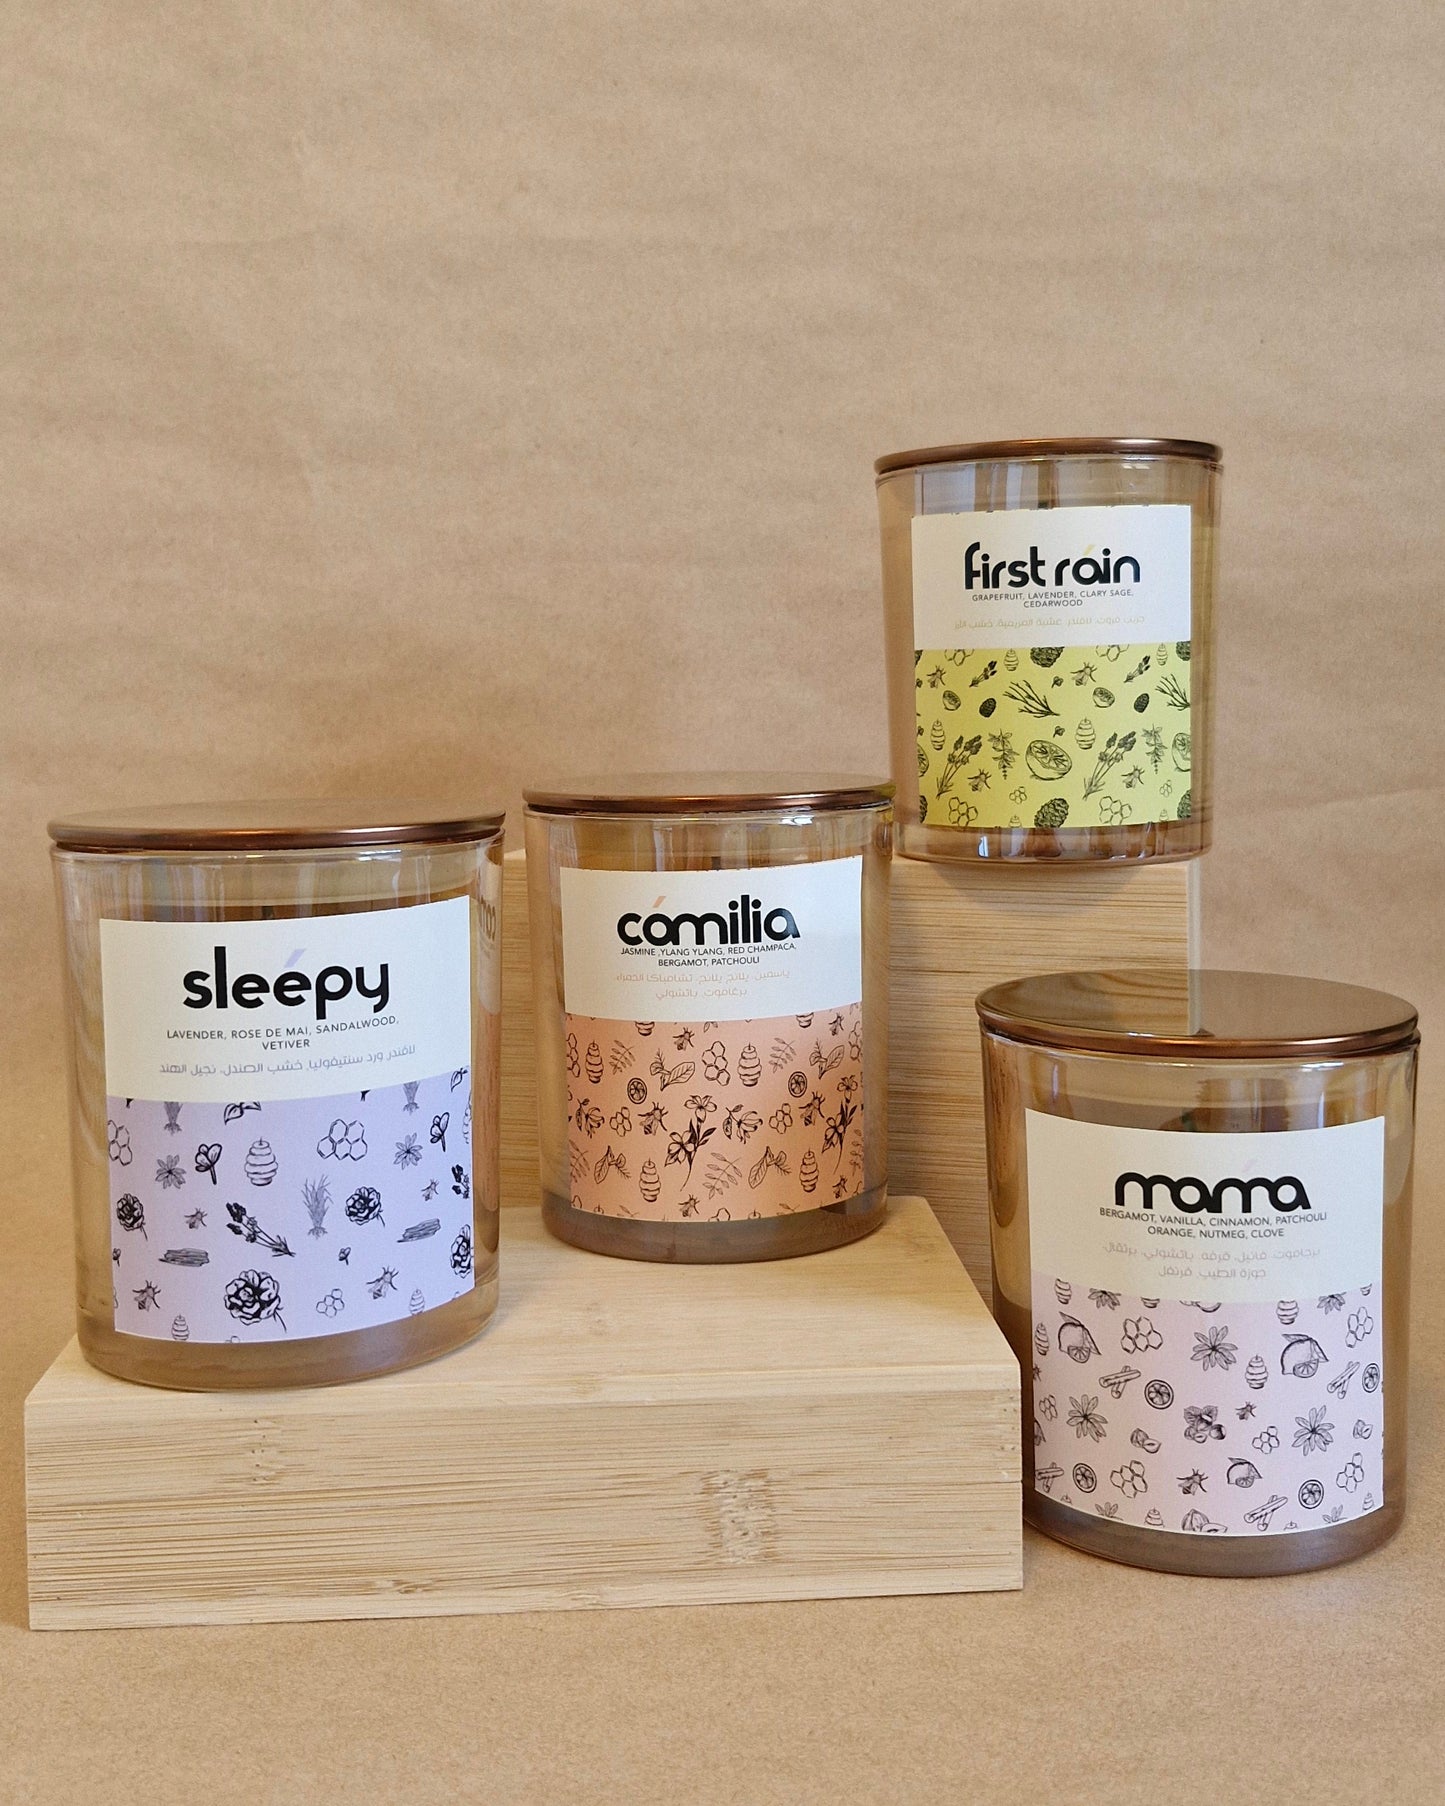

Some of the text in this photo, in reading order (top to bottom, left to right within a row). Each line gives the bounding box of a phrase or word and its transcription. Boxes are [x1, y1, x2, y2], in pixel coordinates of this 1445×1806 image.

[965, 541, 1046, 590] first
[972, 588, 1134, 602] GRAPEFRUIT, LAVENDER, CLARY SAGE,
[1023, 599, 1083, 609] CEDARWOOD
[620, 947, 656, 957] JASMINE
[692, 947, 725, 957] YLANG,
[728, 946, 745, 955] RED
[747, 942, 797, 955] CHAMPACA,
[658, 956, 760, 968] BERGAMOT, PATCHOULI
[167, 1015, 400, 1041] LAVENDER, ROSE DE MAI, SANDALWOOD,
[262, 1039, 310, 1051] VETIVER
[1099, 1206, 1328, 1228] BERGAMOT, VANILLA, CINNAMON, PATCHOULI
[1147, 1226, 1285, 1240] ORANGE, NUTMEG, CLOVE
